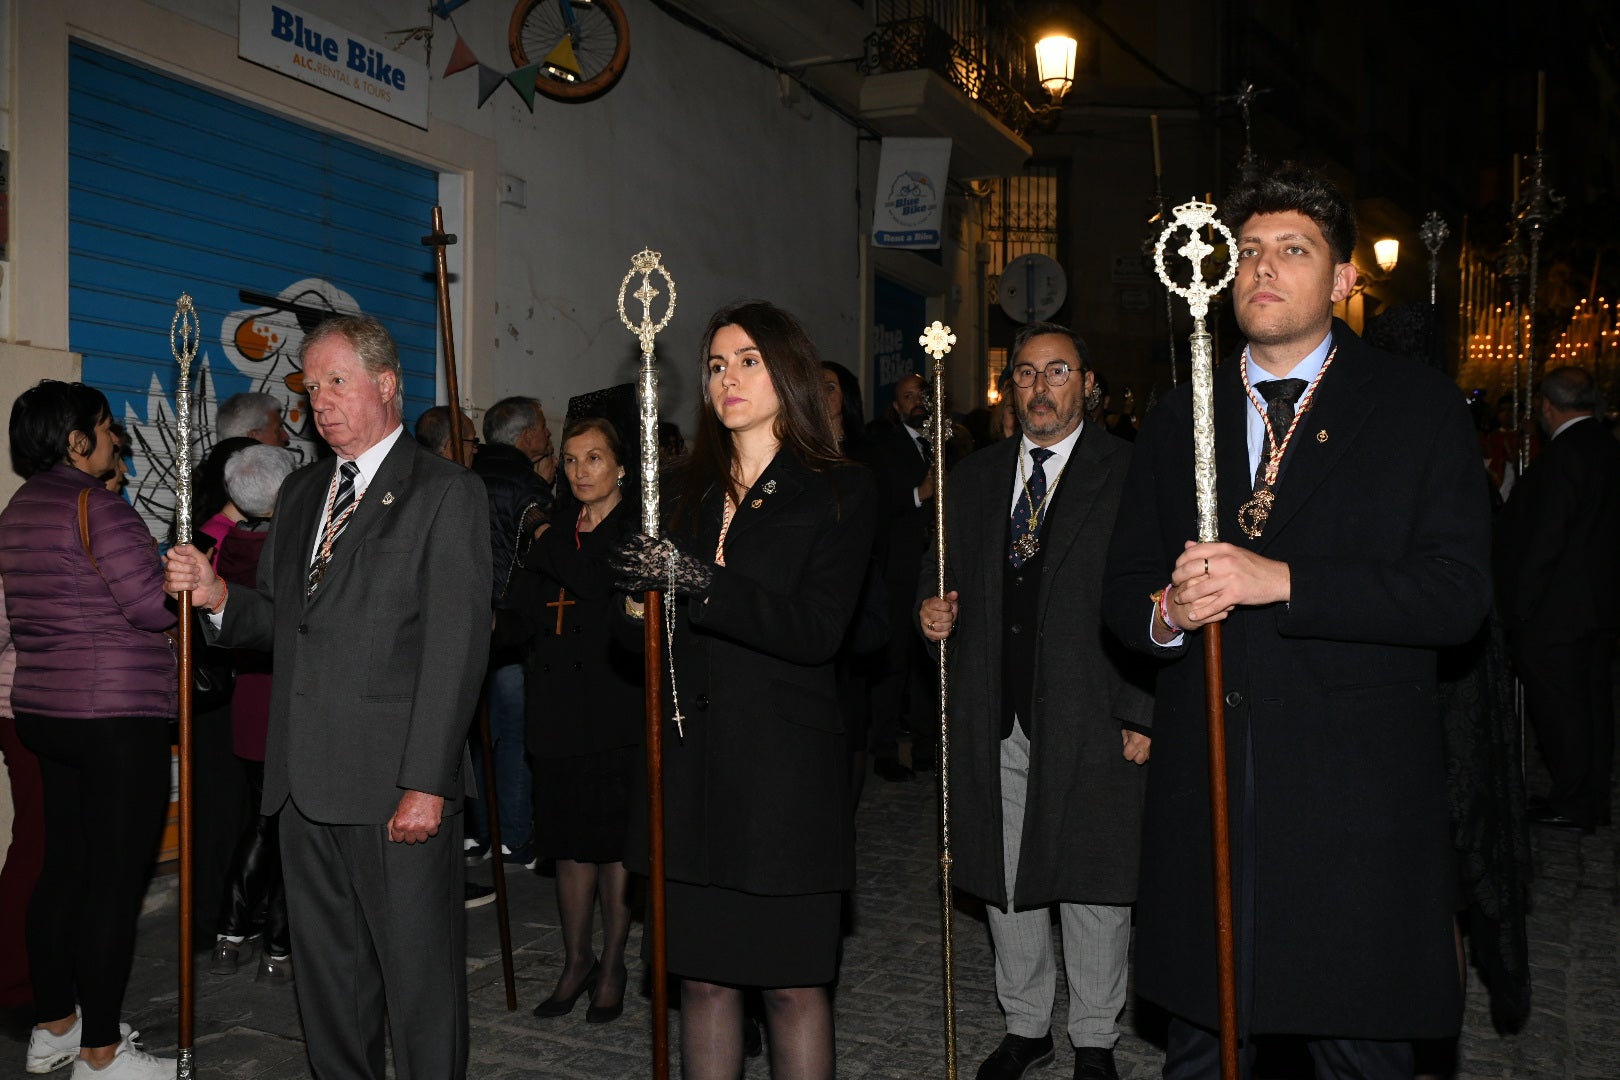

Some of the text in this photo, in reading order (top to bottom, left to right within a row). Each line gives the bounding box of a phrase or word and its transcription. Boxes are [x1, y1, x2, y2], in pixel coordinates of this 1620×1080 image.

[271, 5, 406, 91] Blue Bike
[353, 79, 360, 90] &
[363, 80, 392, 102] TOURS
[895, 198, 920, 208] Blue
[903, 205, 927, 216] Bike
[883, 234, 905, 242] Rent
[914, 232, 933, 241] Bike
